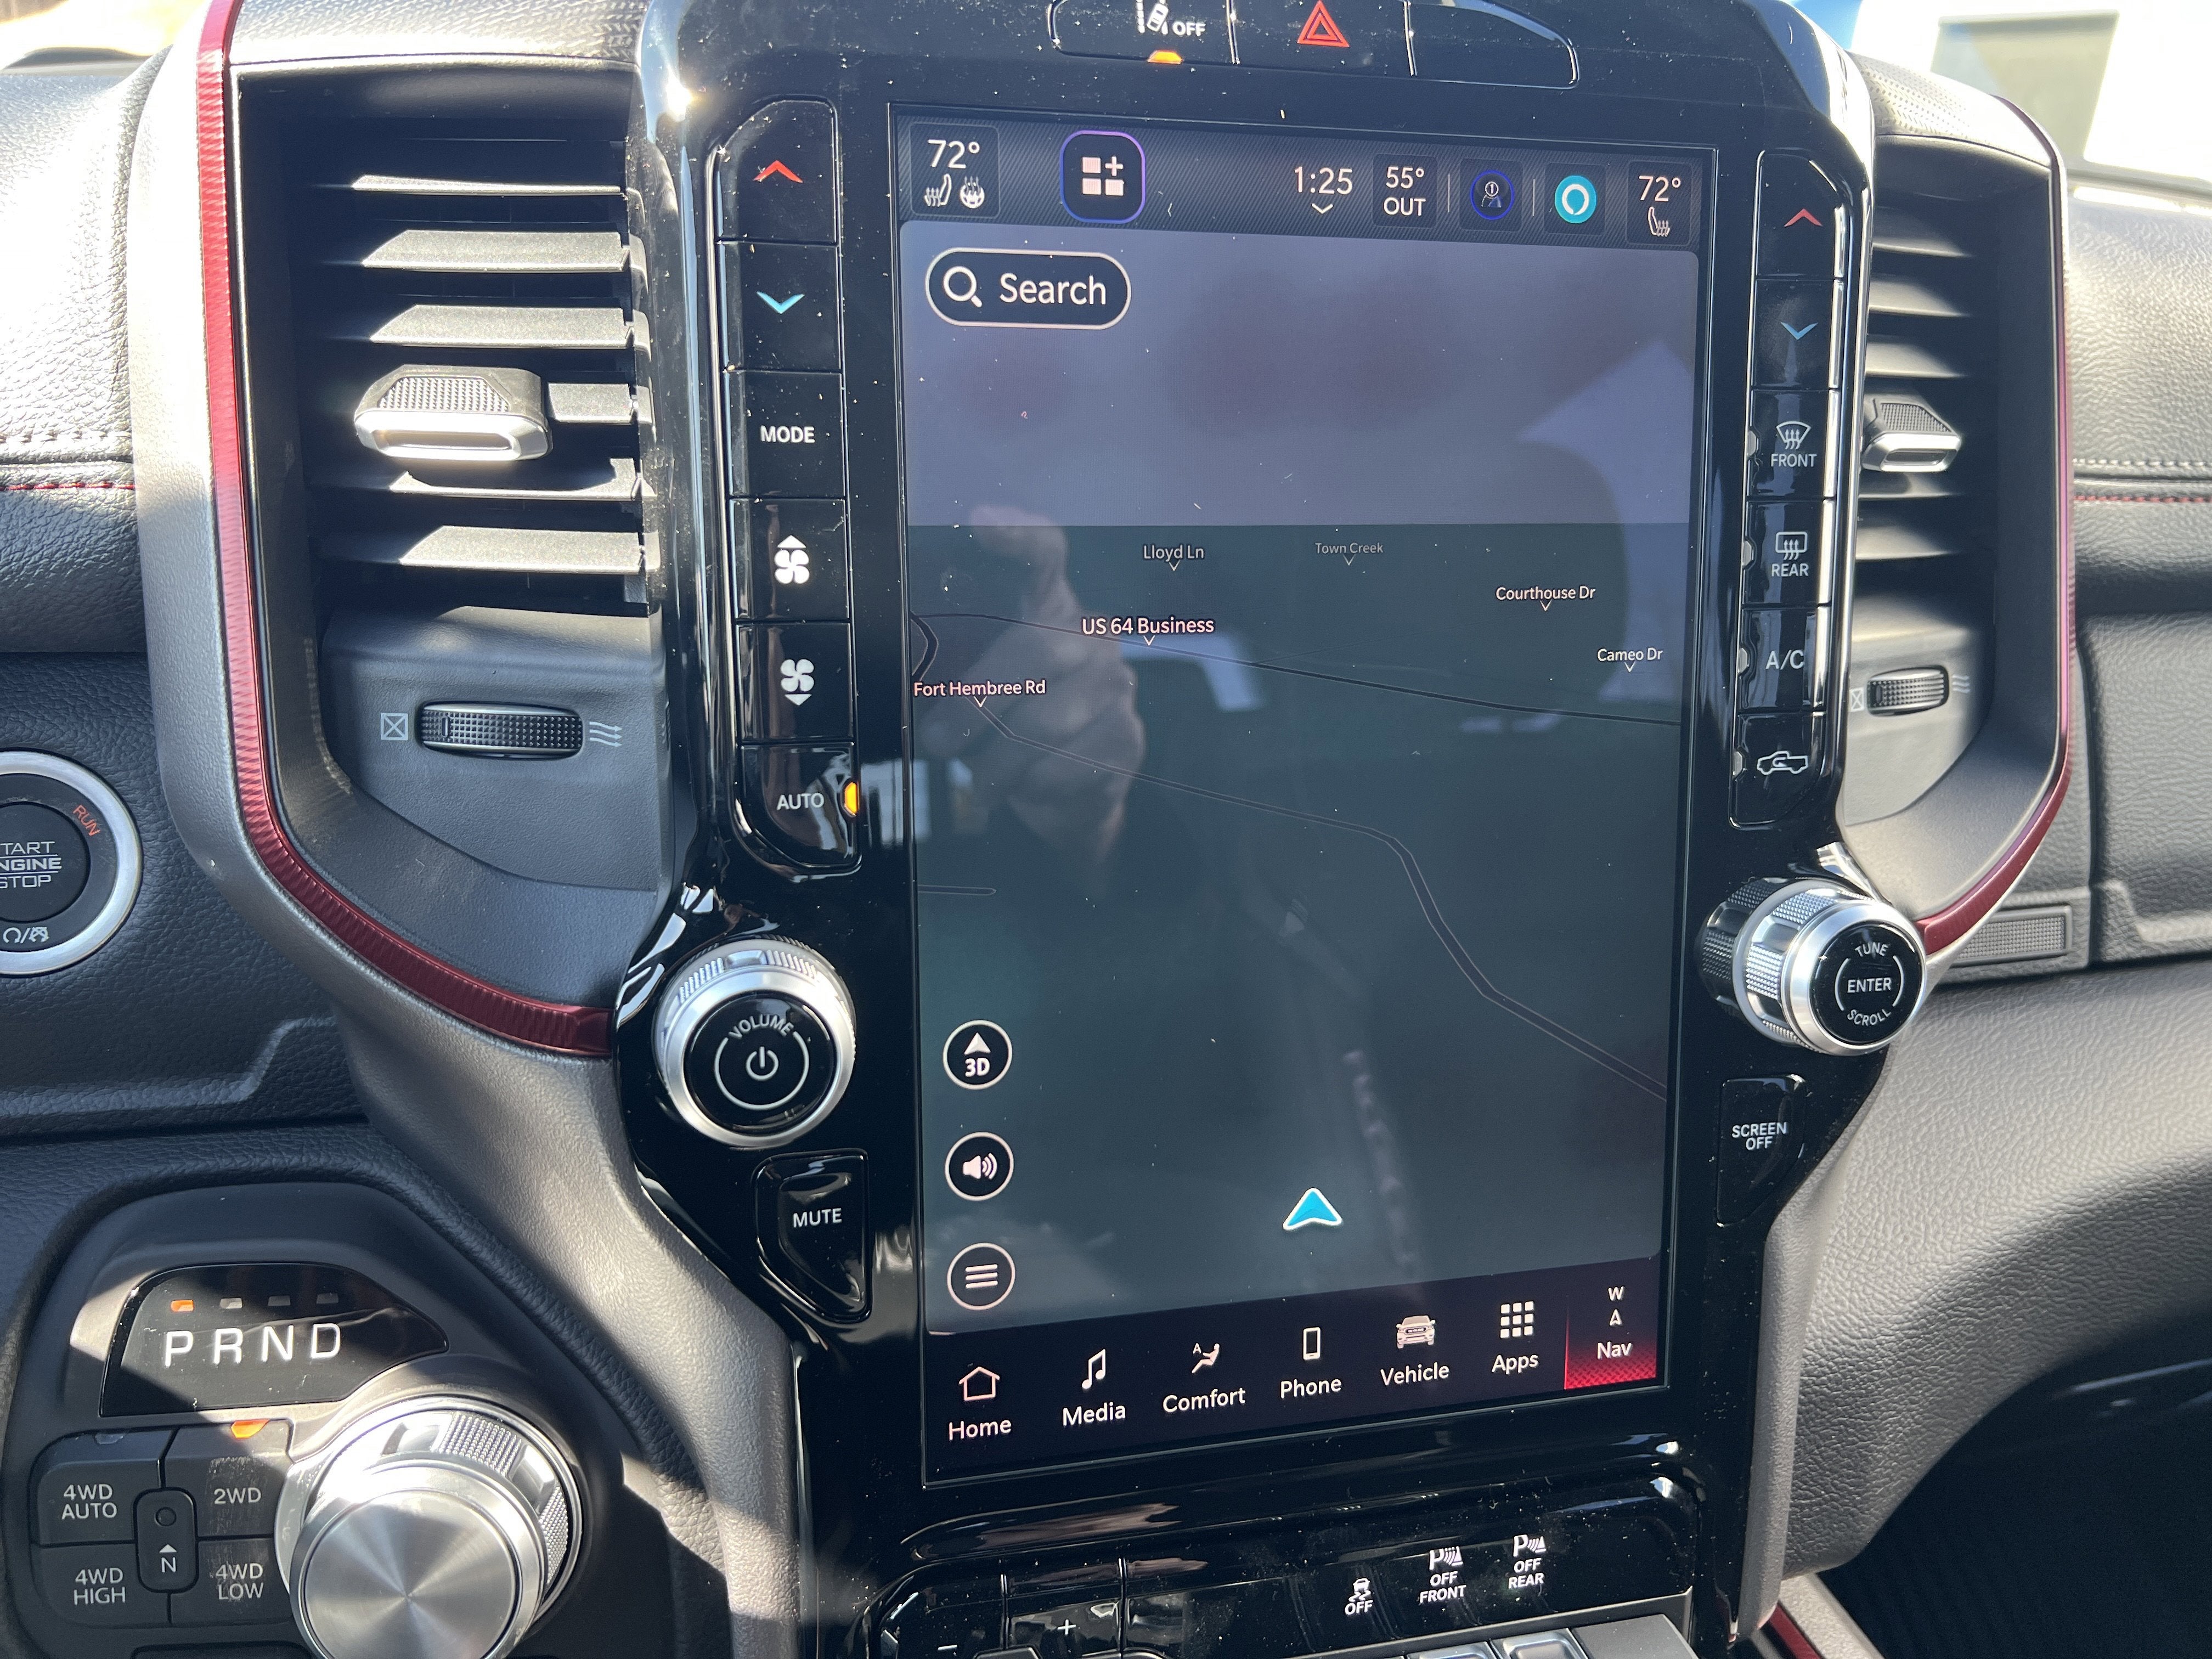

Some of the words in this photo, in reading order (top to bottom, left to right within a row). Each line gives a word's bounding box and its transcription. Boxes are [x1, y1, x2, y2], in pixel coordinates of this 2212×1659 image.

[1172, 21, 1206, 37] OFF
[928, 139, 981, 169] 72°
[1294, 166, 1353, 195] 1:25
[1385, 166, 1425, 189] 55°
[1639, 175, 1681, 202] 72°
[1383, 196, 1426, 216] OUT
[999, 273, 1107, 306] Search
[760, 426, 816, 443] MODE
[1770, 454, 1817, 467] FRONT
[1143, 544, 1184, 561] Lloyd
[1187, 546, 1205, 559] Ln
[1315, 542, 1347, 555] Town
[1349, 541, 1384, 555] Creek
[1771, 563, 1809, 577] REAR
[1495, 585, 1576, 601] Courthouse
[1578, 585, 1595, 599] Dr
[1081, 618, 1107, 635] US
[1110, 618, 1133, 634] 64
[1137, 616, 1215, 633] Business
[1597, 647, 1644, 662] Cameo
[1647, 647, 1663, 661] Dr
[1765, 650, 1805, 670] A/C
[913, 681, 946, 697] Fort
[949, 680, 1022, 696] Hembree
[1025, 679, 1046, 695] Rd
[777, 793, 825, 810] AUTO
[72, 804, 100, 837] RUN
[0, 841, 55, 855] TART
[0, 857, 62, 871] NGINE
[1854, 942, 1889, 957] TUNE
[1847, 977, 1892, 994] ENTER
[1846, 1008, 1892, 1027] SCROLL
[729, 1014, 794, 1041] VOLUME
[964, 1058, 991, 1077] 3D
[1731, 1121, 1788, 1138] SCREEN
[1745, 1136, 1773, 1151] OFF
[793, 1207, 843, 1228] MUTE
[1608, 1285, 1624, 1301] W
[165, 1330, 194, 1367] P
[213, 1328, 243, 1364] R
[260, 1325, 294, 1361] N
[311, 1323, 341, 1358] D
[1596, 1341, 1633, 1360] Nav
[1491, 1352, 1539, 1374] Apps
[1380, 1361, 1450, 1387] Vehicle
[1280, 1378, 1342, 1400] Phone
[1163, 1387, 1246, 1414] Comfort
[1062, 1401, 1126, 1427] Media
[948, 1418, 1012, 1441] Home
[63, 1484, 113, 1500] 4WD
[213, 1487, 262, 1504] 2WD
[61, 1503, 117, 1520] AUTO
[161, 1556, 177, 1573] N
[216, 1563, 263, 1580] 4WD
[1514, 1558, 1542, 1573] OFF
[75, 1568, 123, 1584] 4WD
[1430, 1571, 1458, 1587] OFF
[1508, 1573, 1544, 1589] REAR
[74, 1587, 126, 1605] HIGH
[218, 1583, 264, 1599] LOW
[1419, 1585, 1466, 1604] FRONT
[1345, 1600, 1373, 1615] OFF
